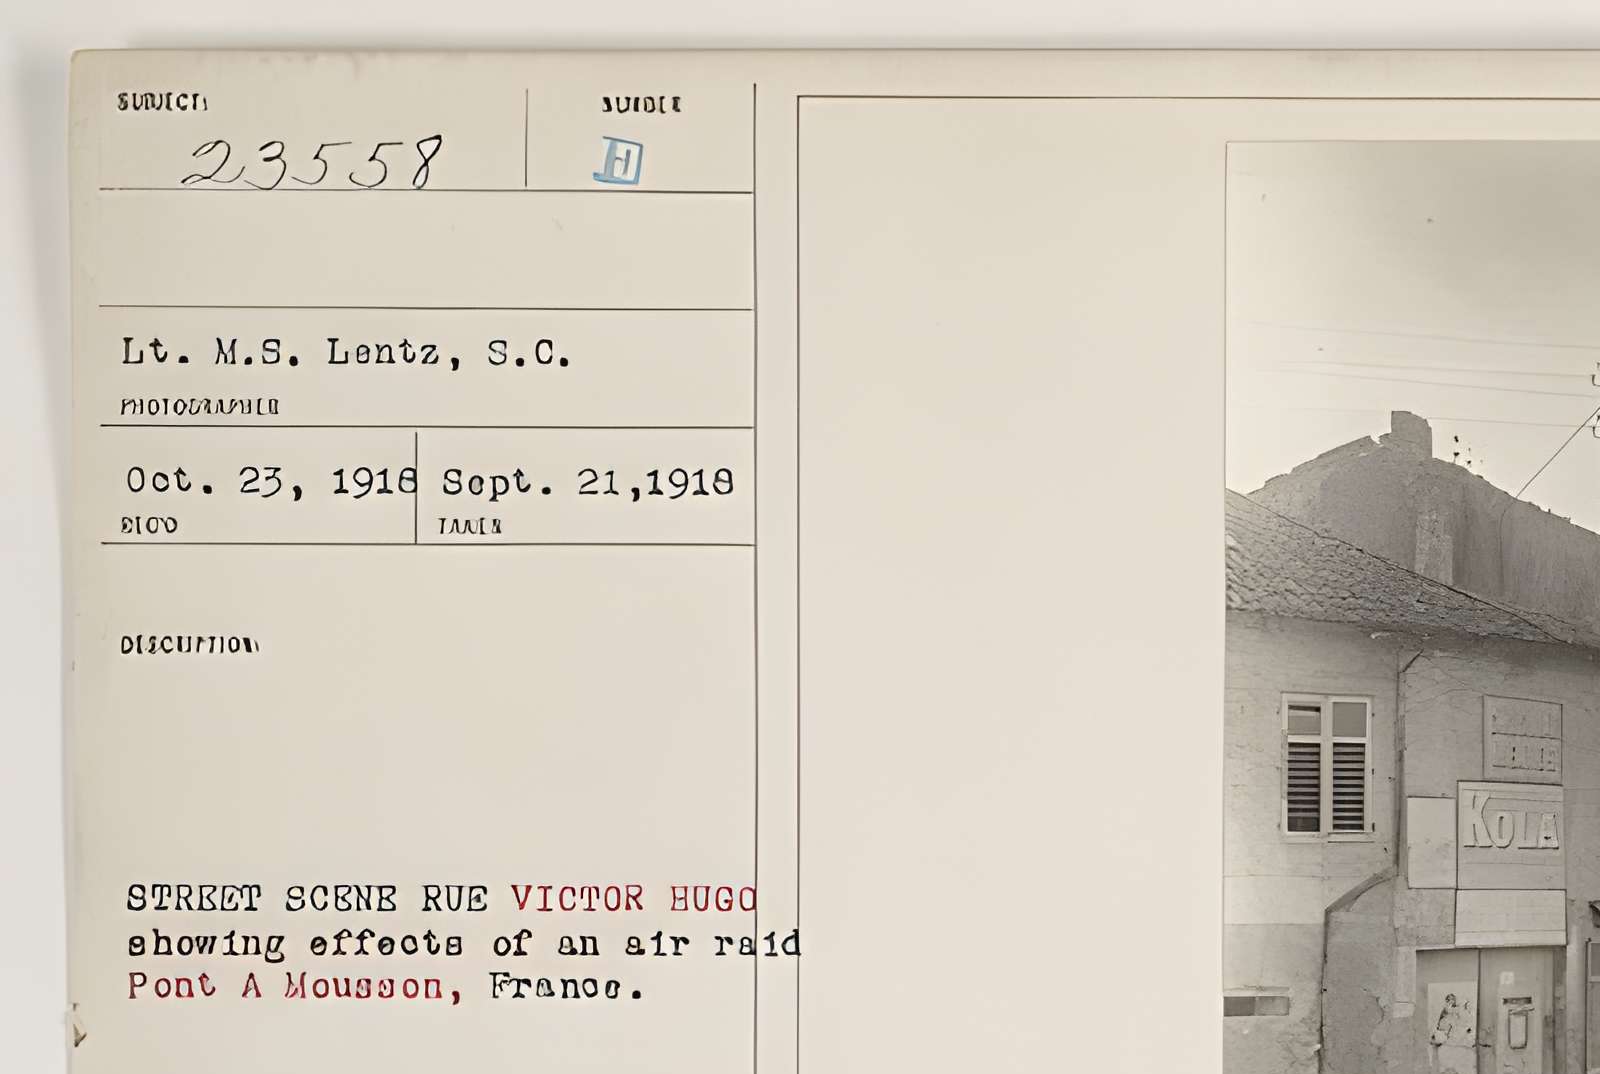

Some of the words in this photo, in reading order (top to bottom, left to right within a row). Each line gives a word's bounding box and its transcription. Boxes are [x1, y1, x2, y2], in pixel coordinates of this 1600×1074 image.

[181, 134, 444, 189] 23558
[123, 337, 191, 366] Lt.
[215, 337, 300, 368] M.S.
[327, 338, 461, 373] Lentz,
[488, 339, 570, 369] S.C.
[127, 467, 214, 496] Oct.
[240, 467, 304, 503] 23,
[333, 467, 416, 496] 1918
[443, 469, 553, 504] Sept.
[127, 884, 263, 913] STREET
[286, 885, 398, 913] SCENE
[422, 885, 489, 913] RUE
[511, 885, 645, 914] VICTOR
[671, 886, 755, 914] HUGO
[129, 928, 287, 963] showing
[310, 928, 464, 958] effects
[493, 929, 533, 958] of
[558, 936, 601, 958] an
[625, 931, 692, 958] air
[714, 928, 802, 958] raid
[129, 972, 218, 1001] Pont
[242, 972, 263, 1000] A
[285, 972, 462, 1007] Mousson,
[489, 972, 643, 1001] France.
